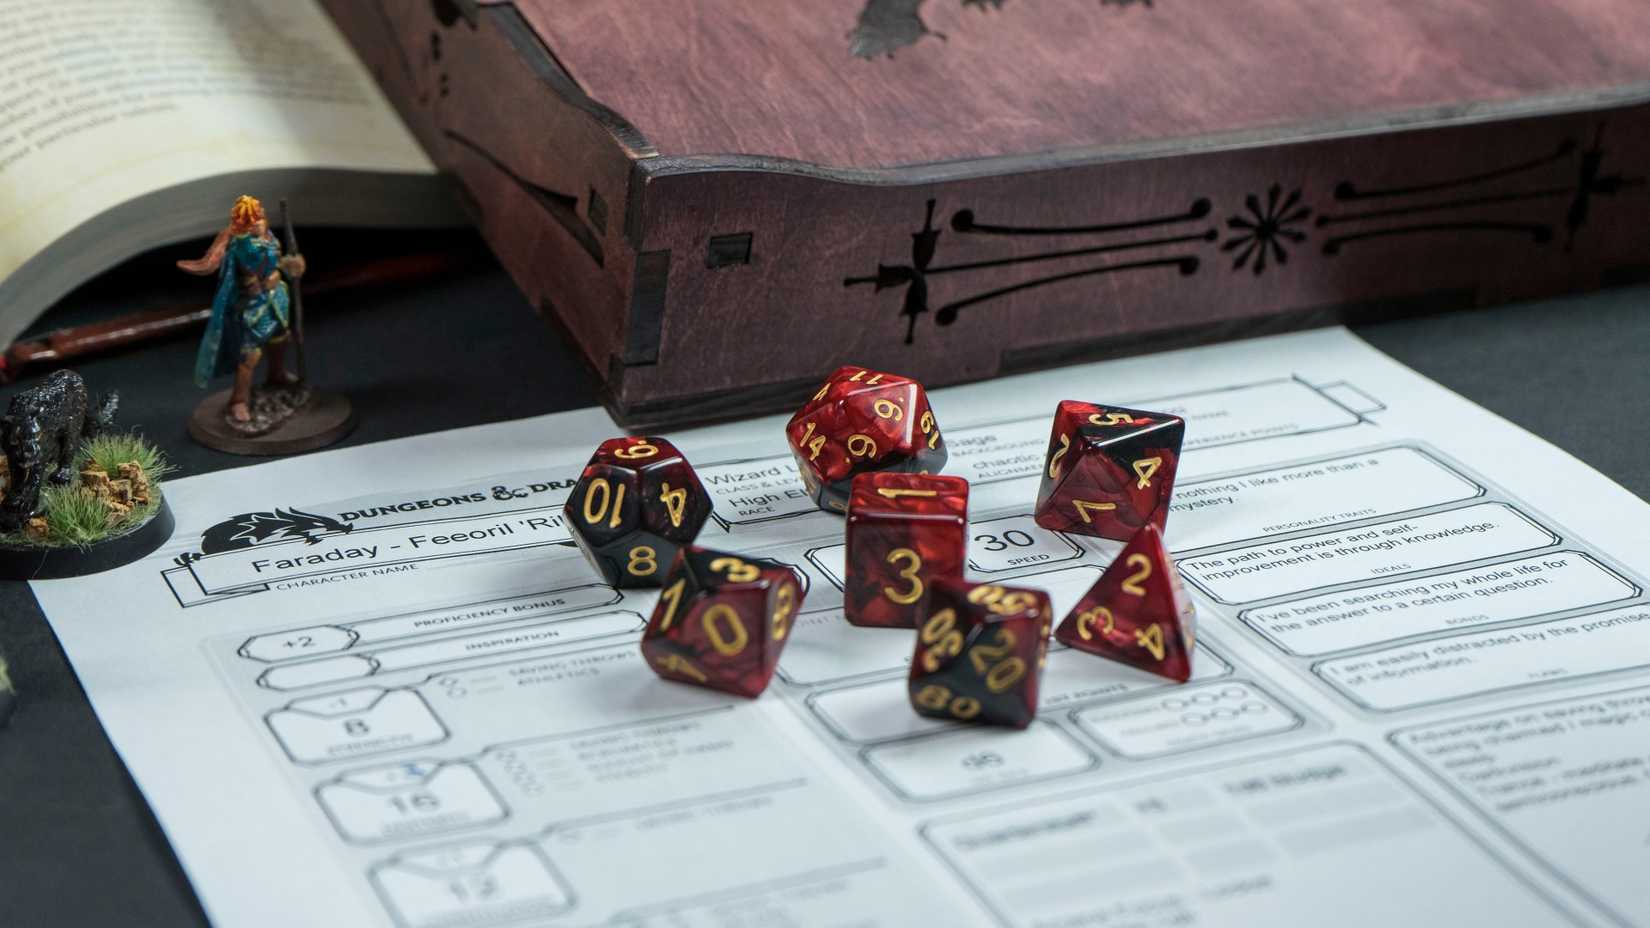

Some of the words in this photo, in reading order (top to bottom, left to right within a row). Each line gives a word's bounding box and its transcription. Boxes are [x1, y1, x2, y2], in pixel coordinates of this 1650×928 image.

[850, 370, 884, 385] 11
[704, 466, 781, 486] Wizard
[1132, 456, 1162, 490] 4
[1175, 482, 1240, 500] nothing
[1247, 476, 1280, 488] like
[1281, 469, 1324, 482] more
[337, 492, 487, 522] DUNGEONS
[528, 478, 577, 494] DRA
[660, 481, 687, 528] 4
[729, 493, 781, 507] High
[784, 488, 808, 499] El
[877, 487, 938, 499] 1
[738, 506, 777, 517] RACE
[1262, 514, 1338, 533] PERSONALITY
[1339, 507, 1378, 520] TRAITS
[251, 545, 378, 573] Faraday
[408, 523, 515, 549] Feeoril
[974, 529, 1036, 552] 30
[1186, 555, 1225, 573] The
[1227, 547, 1268, 568] path
[1268, 544, 1288, 557] to
[1290, 537, 1343, 555] power
[1346, 530, 1380, 544] and
[1381, 523, 1419, 537] self-
[1198, 551, 1319, 583] improvement
[1318, 549, 1335, 561] is
[1334, 537, 1402, 557] through
[1404, 520, 1500, 545] knowledge.
[626, 545, 658, 577] 8
[709, 557, 761, 583] 3
[1007, 553, 1050, 567] SPEED
[1121, 553, 1153, 597] 2
[1370, 563, 1412, 576] IDEALS
[276, 570, 369, 592] CHARACTER
[371, 563, 420, 577] NAME
[883, 547, 924, 605] 3
[1255, 609, 1292, 624] I've
[1292, 600, 1342, 616] been
[1343, 583, 1431, 605] searching
[1431, 579, 1459, 591] my
[1460, 570, 1514, 585] whole
[1515, 563, 1544, 575] life
[1543, 558, 1569, 569] for
[413, 605, 510, 629] PROFICIENCY
[512, 598, 567, 613] BONUS
[1270, 621, 1303, 634] the
[1305, 608, 1370, 627] answer
[1373, 602, 1393, 614] to
[1397, 601, 1409, 610] a
[1411, 591, 1472, 607] certain
[1473, 576, 1553, 598] question.
[703, 603, 749, 657] 0
[1076, 606, 1115, 641] 3
[282, 635, 318, 648] +2
[465, 630, 560, 651] INSPIRATION
[1135, 622, 1166, 661] 4
[1431, 634, 1521, 655] distracted
[1521, 631, 1546, 643] by
[1546, 625, 1579, 638] the
[971, 627, 1027, 694] 20
